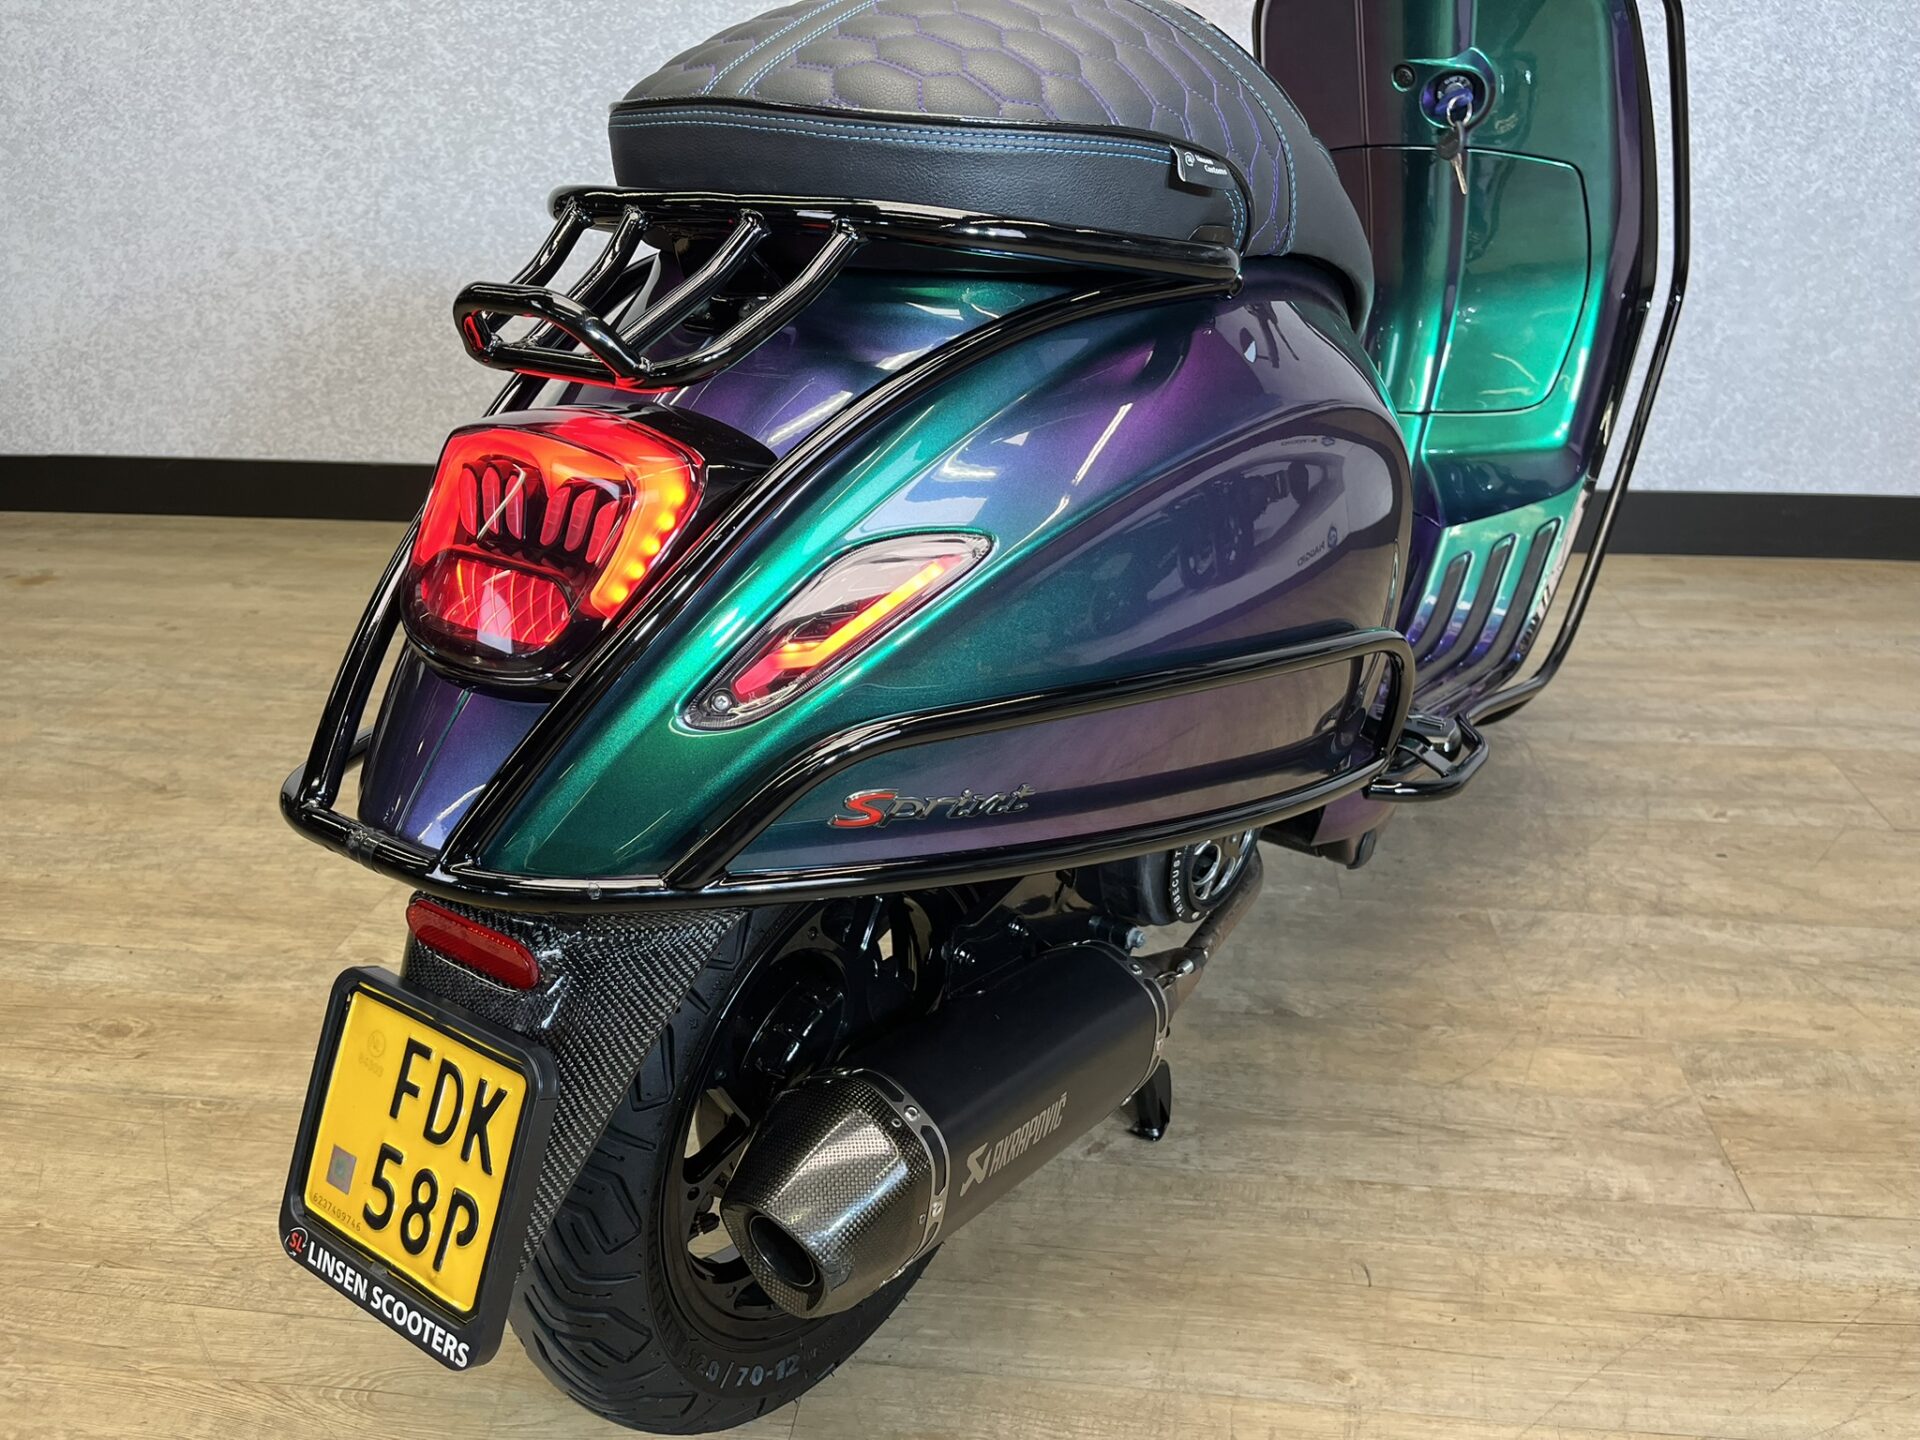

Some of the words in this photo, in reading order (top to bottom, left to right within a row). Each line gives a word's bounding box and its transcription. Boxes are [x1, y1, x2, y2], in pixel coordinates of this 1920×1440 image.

[827, 783, 1036, 829] Sprint
[390, 1037, 508, 1176] FDK
[289, 1231, 303, 1254] SL
[362, 1143, 479, 1273] 58P
[307, 1240, 368, 1301] LINSEN
[370, 1285, 470, 1368] SCOOTERS
